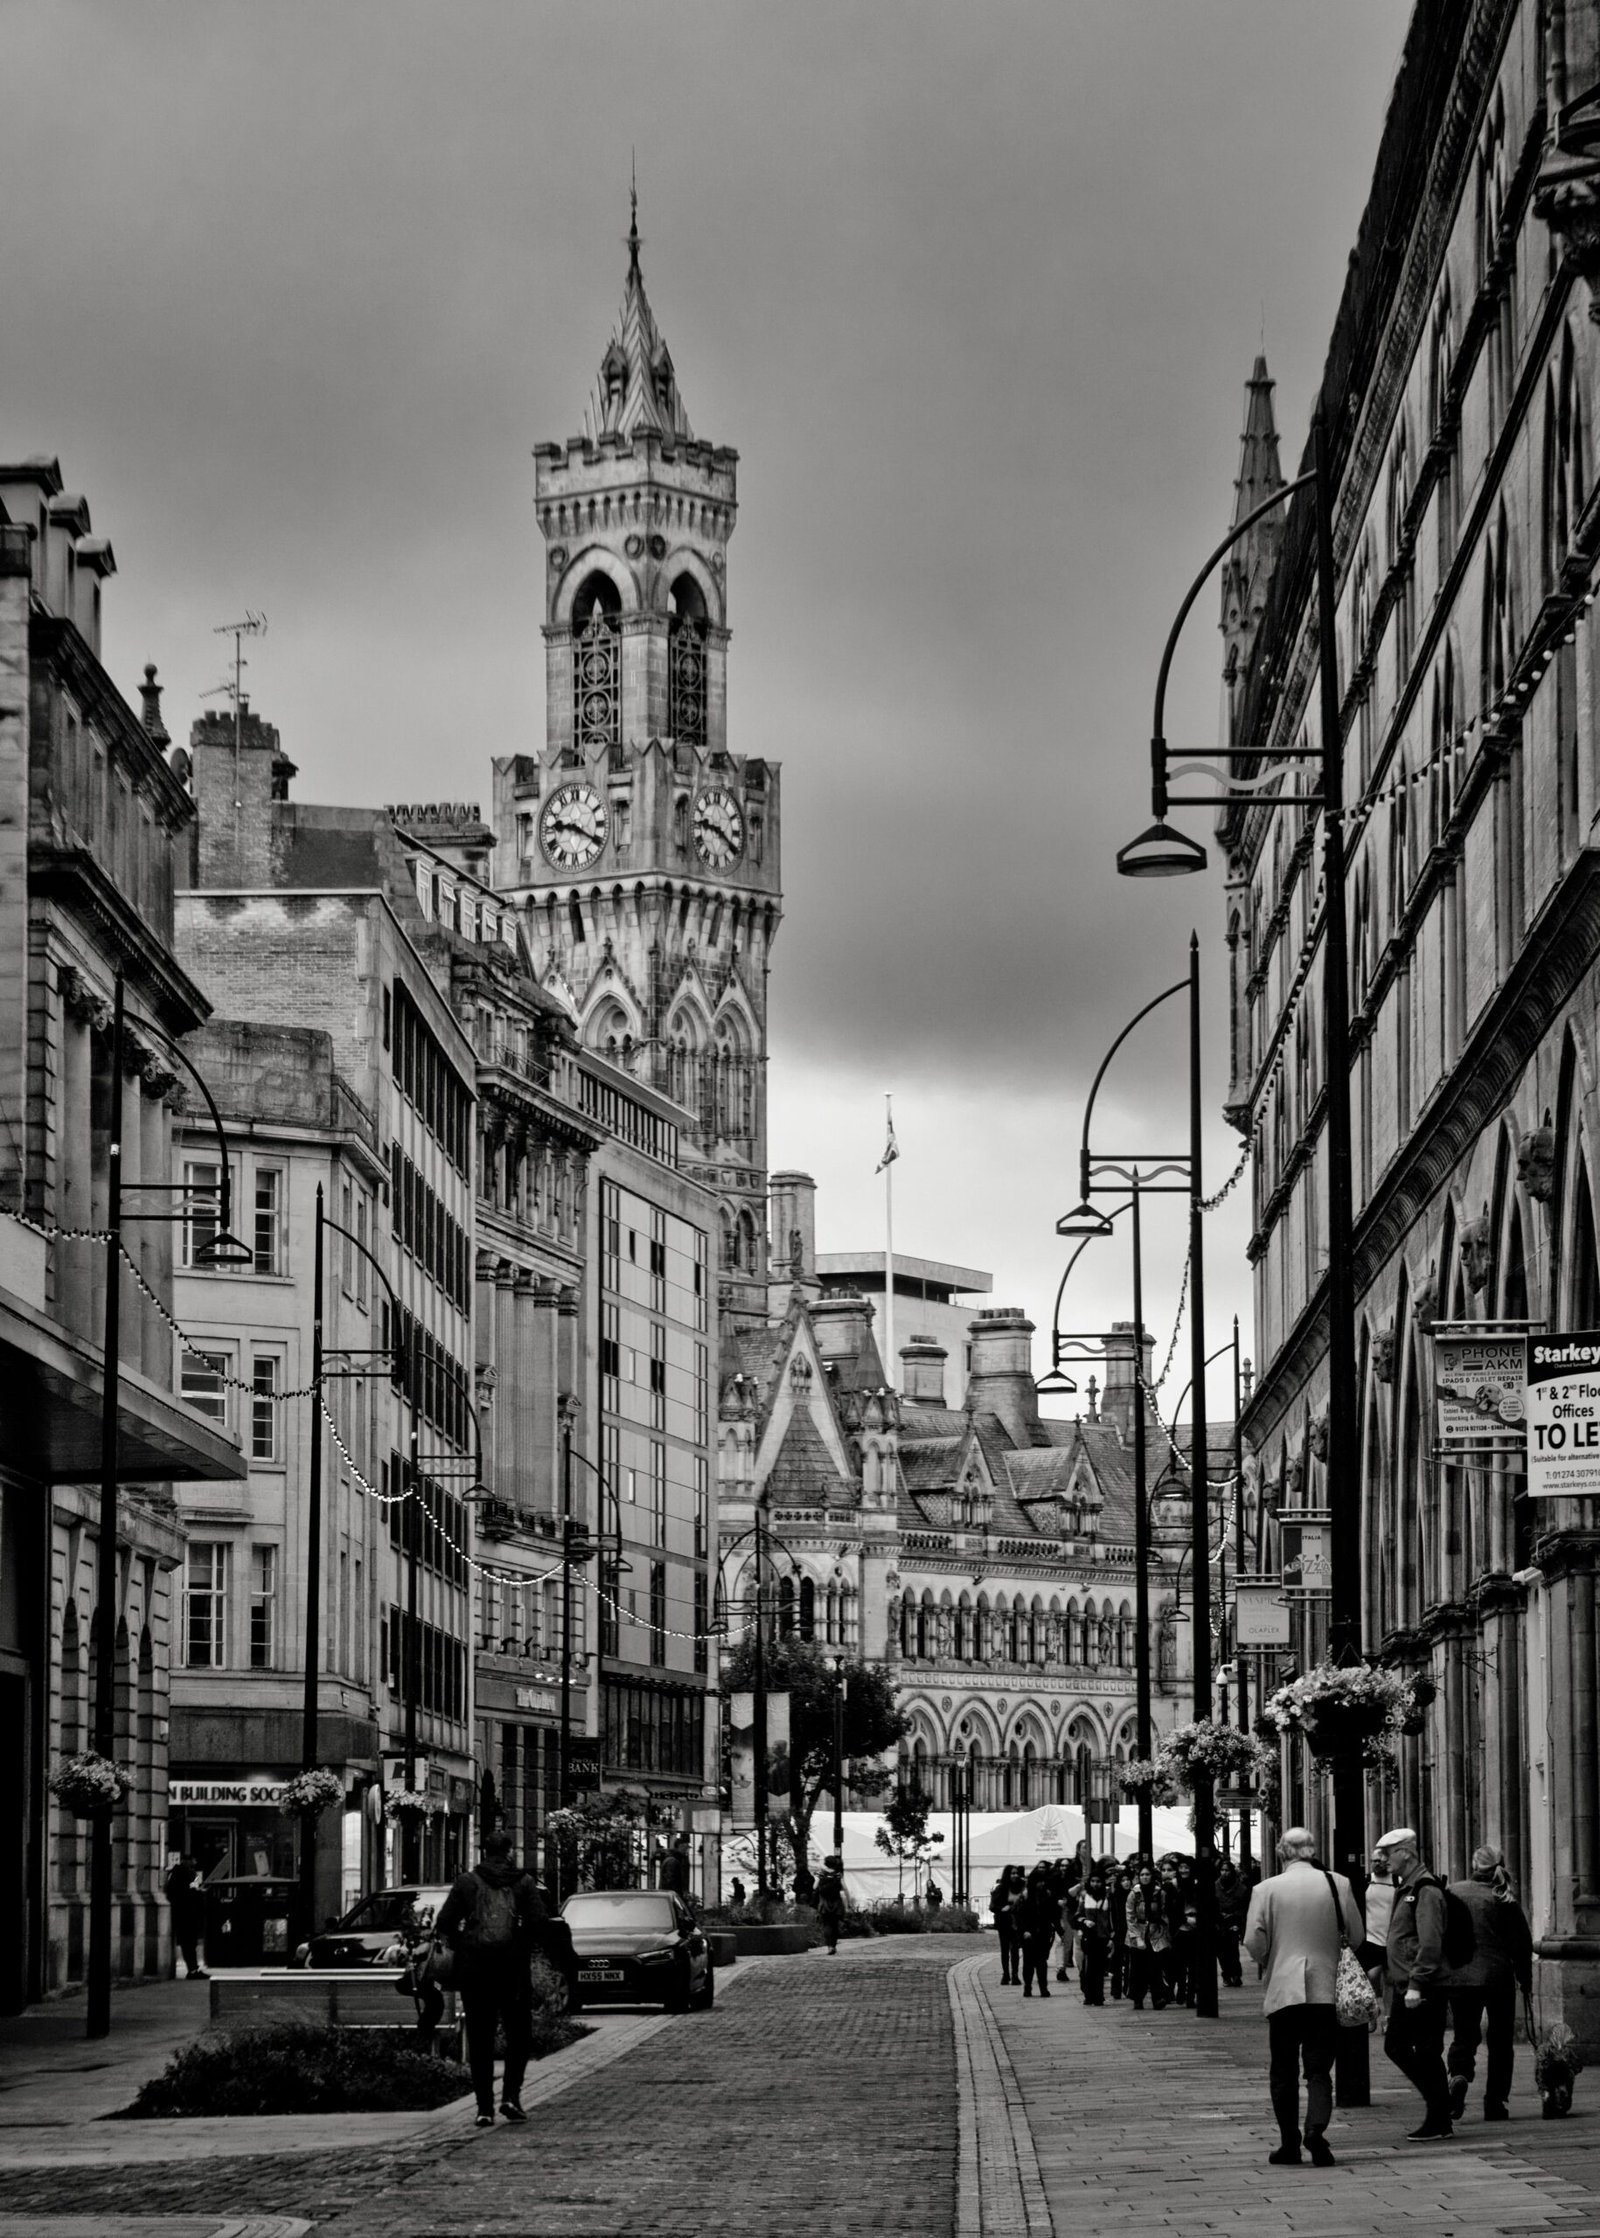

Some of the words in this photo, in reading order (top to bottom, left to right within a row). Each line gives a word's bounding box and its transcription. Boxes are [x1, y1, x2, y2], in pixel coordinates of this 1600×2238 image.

[1461, 1347, 1521, 1359] PHONE
[1485, 1359, 1523, 1370] AKM
[1550, 1387, 1558, 1400] &
[1552, 1404, 1594, 1419] Offices
[1534, 1423, 1566, 1450] TO
[1574, 1421, 1600, 1448] LE
[1558, 1454, 1567, 1462] for
[1568, 1452, 1599, 1461] alternative
[1552, 1469, 1575, 1480] 01274
[568, 1763, 599, 1773] BANK
[180, 1786, 247, 1801] BUILDING
